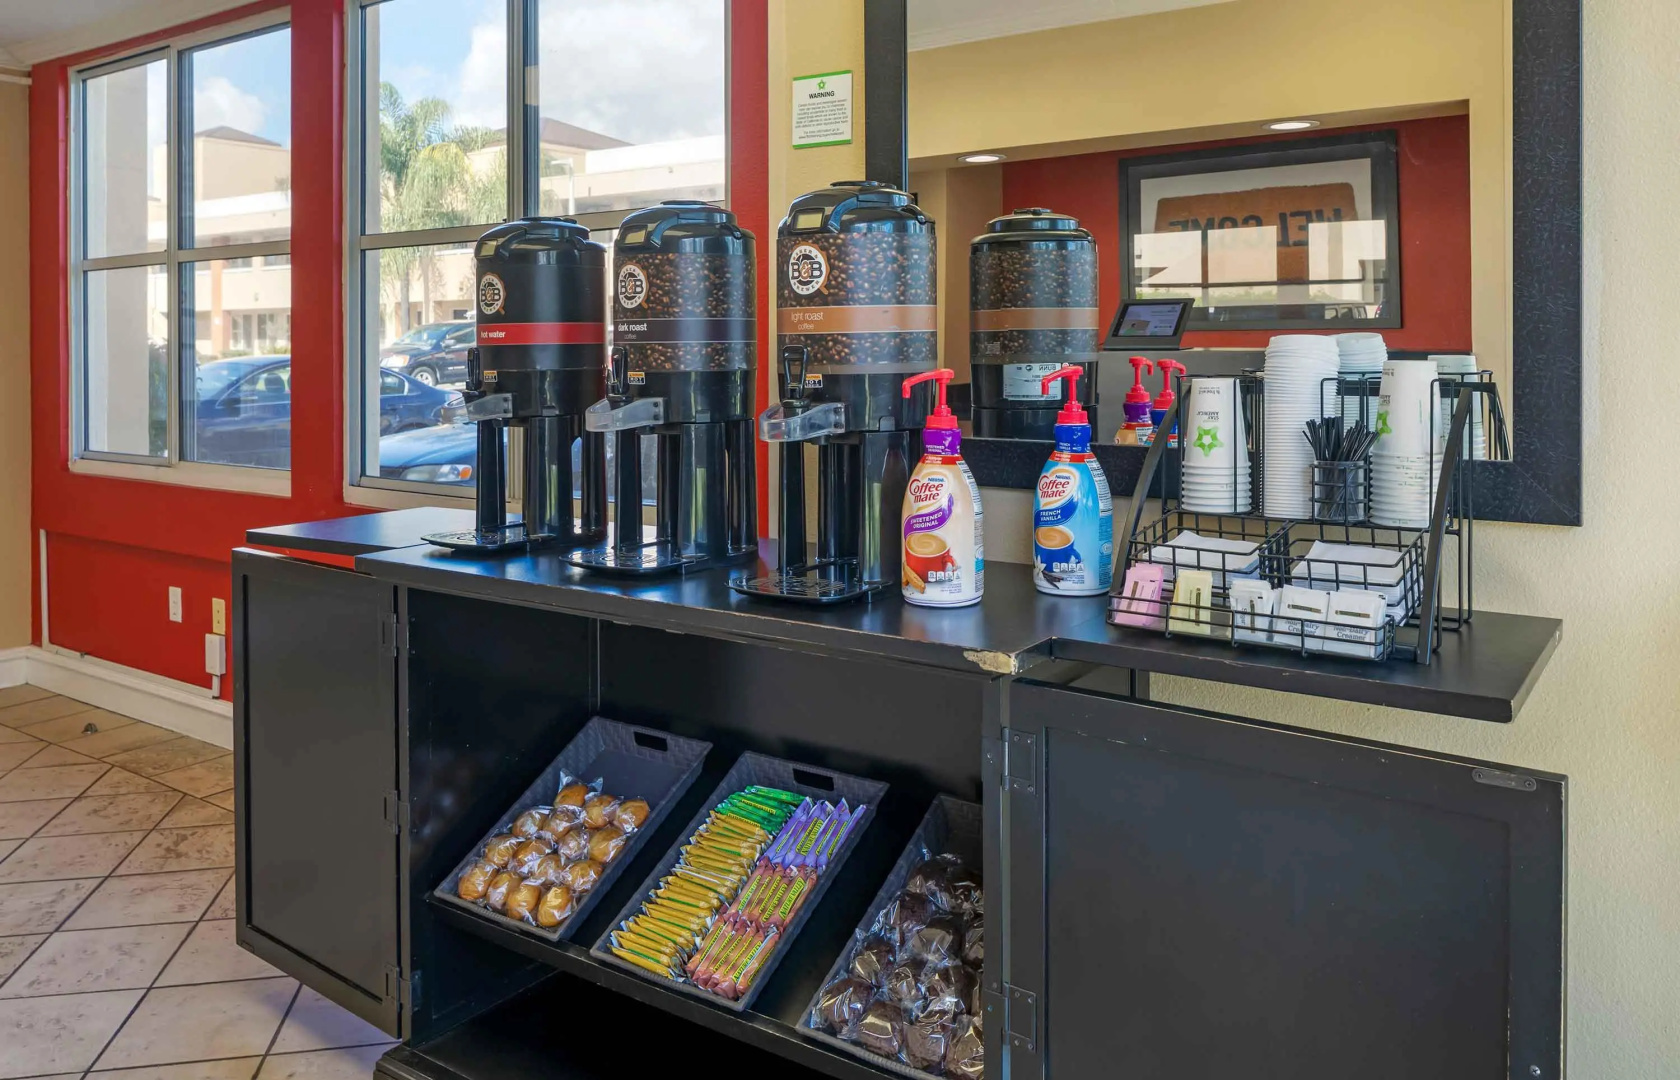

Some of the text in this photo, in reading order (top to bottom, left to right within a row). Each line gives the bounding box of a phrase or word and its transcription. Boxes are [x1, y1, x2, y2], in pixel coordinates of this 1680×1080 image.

[809, 90, 835, 99] WARNING
[791, 261, 823, 280] B&B
[620, 279, 644, 295] B&B
[481, 287, 501, 302] B&B
[804, 312, 824, 321] roast
[618, 323, 647, 332] dark roast
[909, 479, 943, 496] Coffee
[1039, 475, 1070, 491] Coffee
[914, 492, 940, 503] mate
[1040, 489, 1065, 498] mate
[910, 512, 942, 524] SWEETENED
